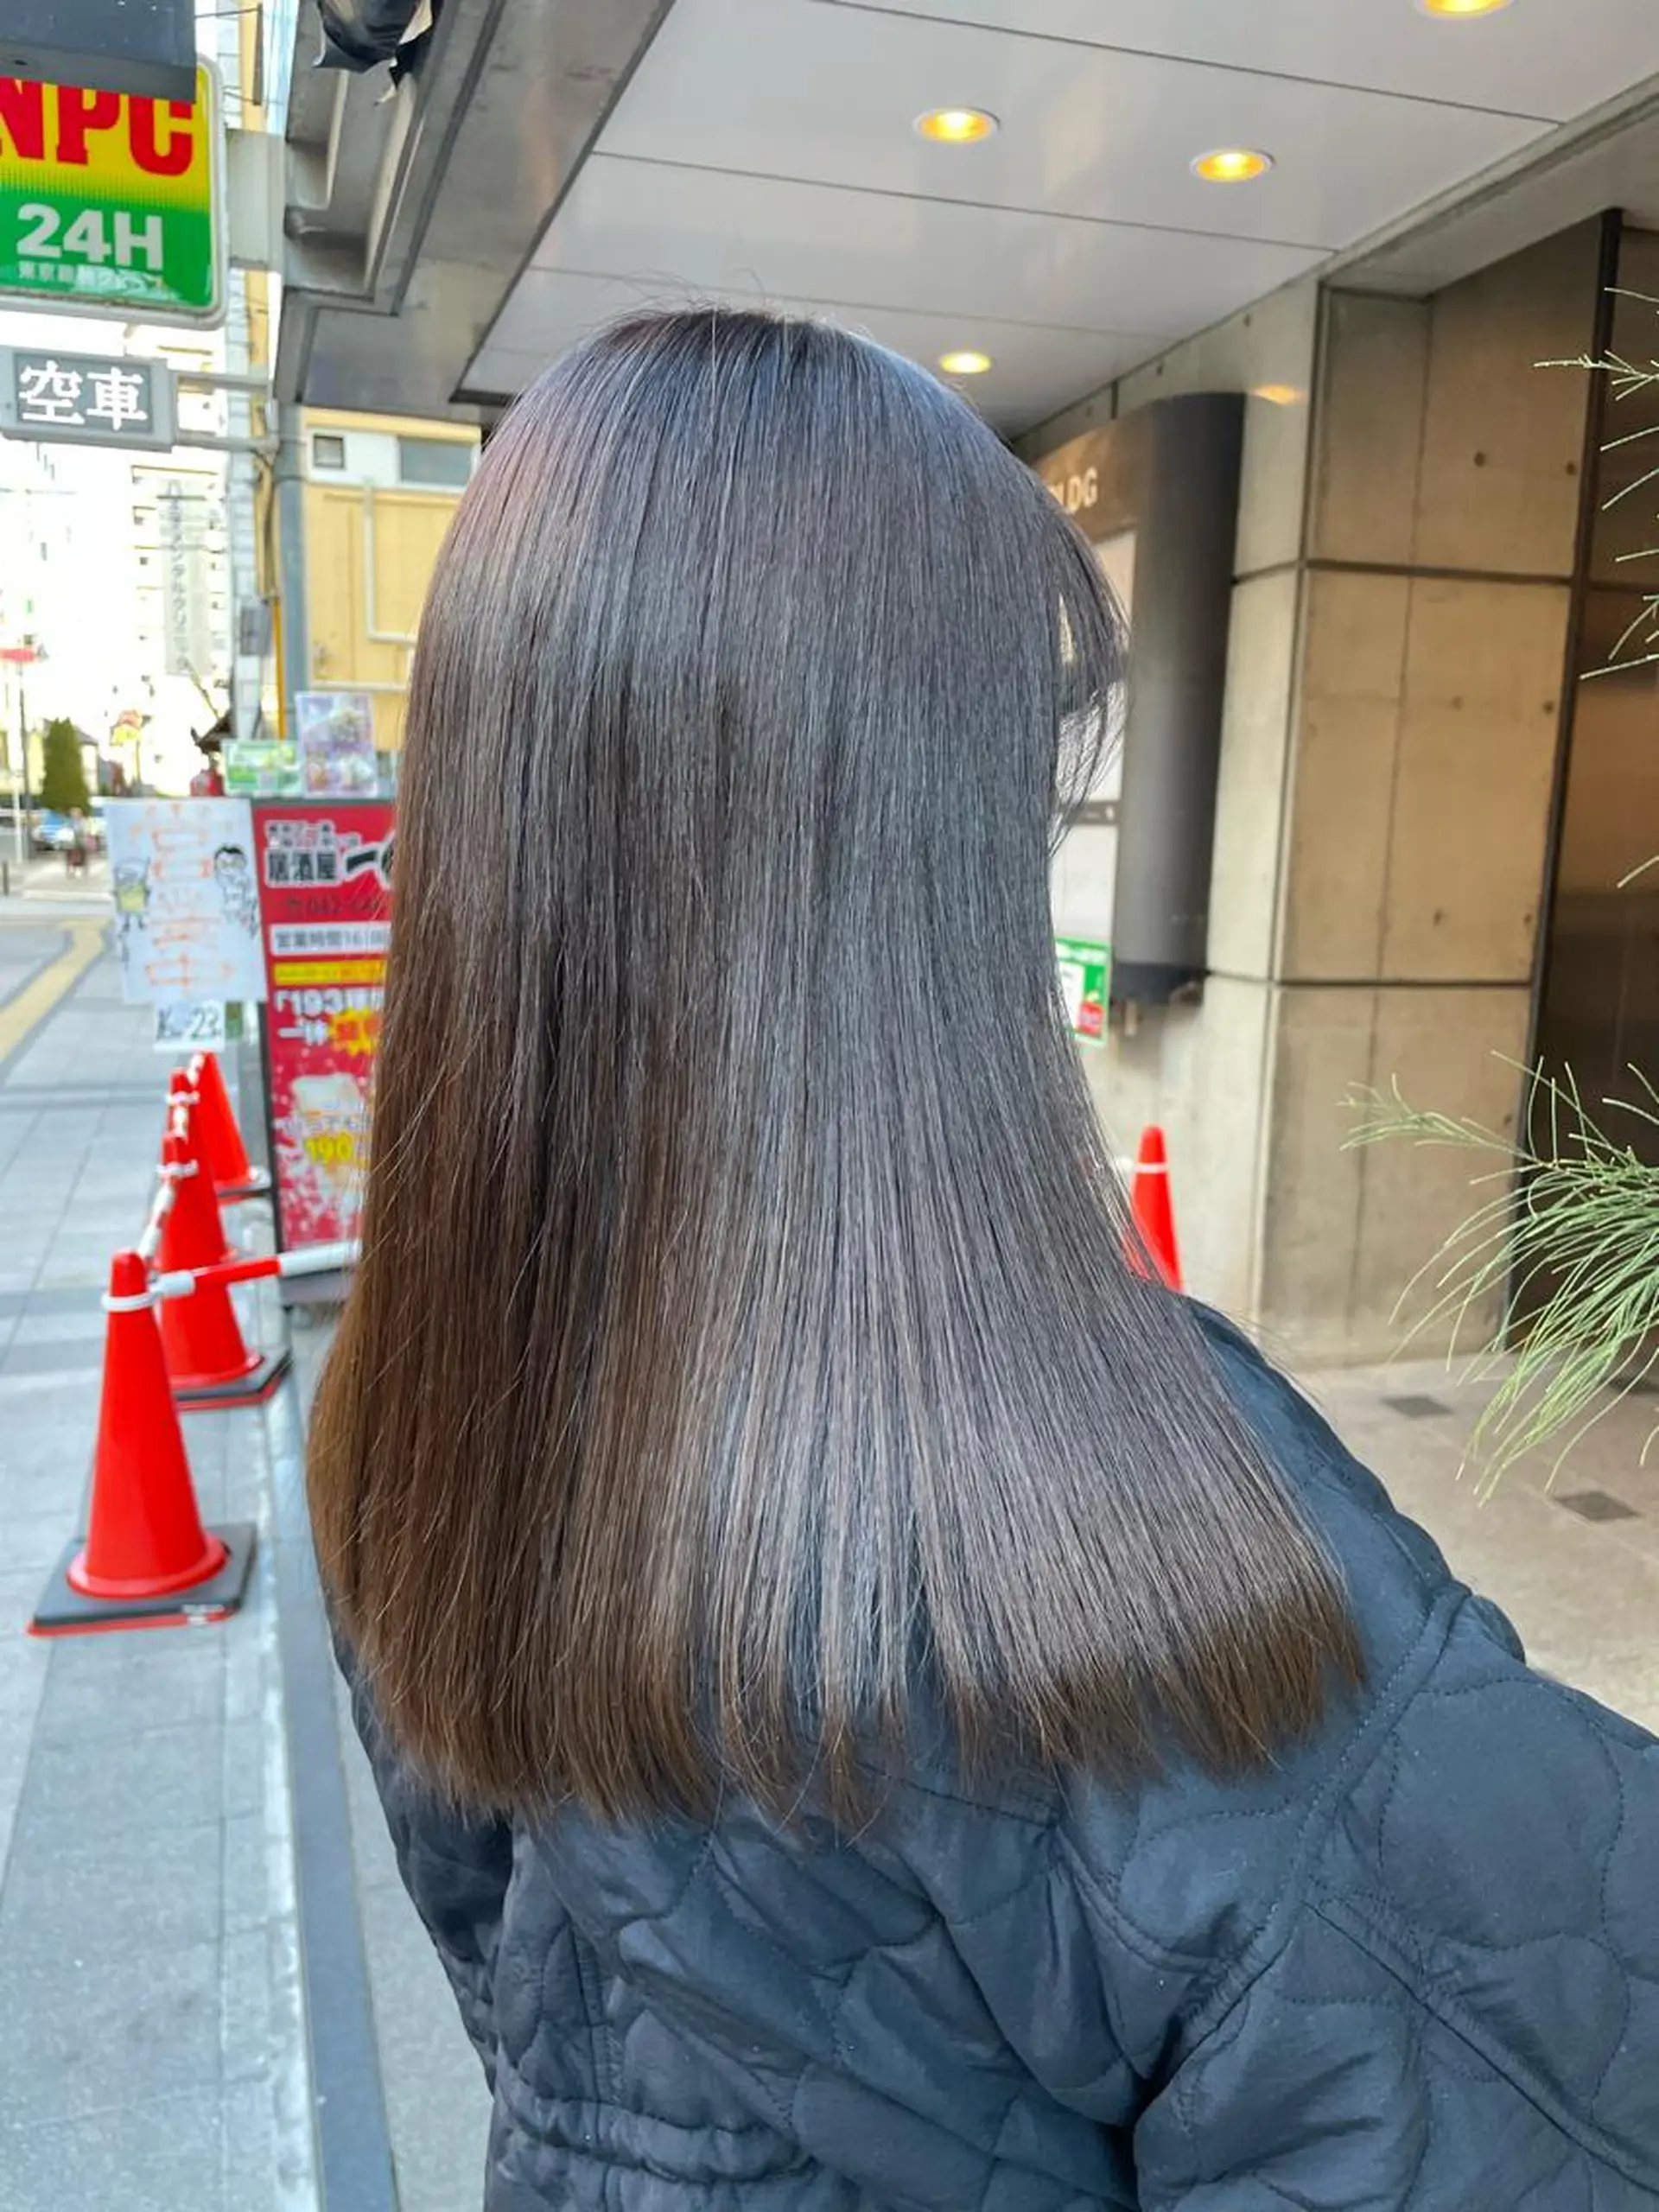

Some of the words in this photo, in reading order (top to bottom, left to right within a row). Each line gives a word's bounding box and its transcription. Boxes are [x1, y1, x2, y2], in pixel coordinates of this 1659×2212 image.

[0, 74, 194, 177] NPC
[16, 202, 164, 274] 24H
[19, 360, 148, 430] 空車
